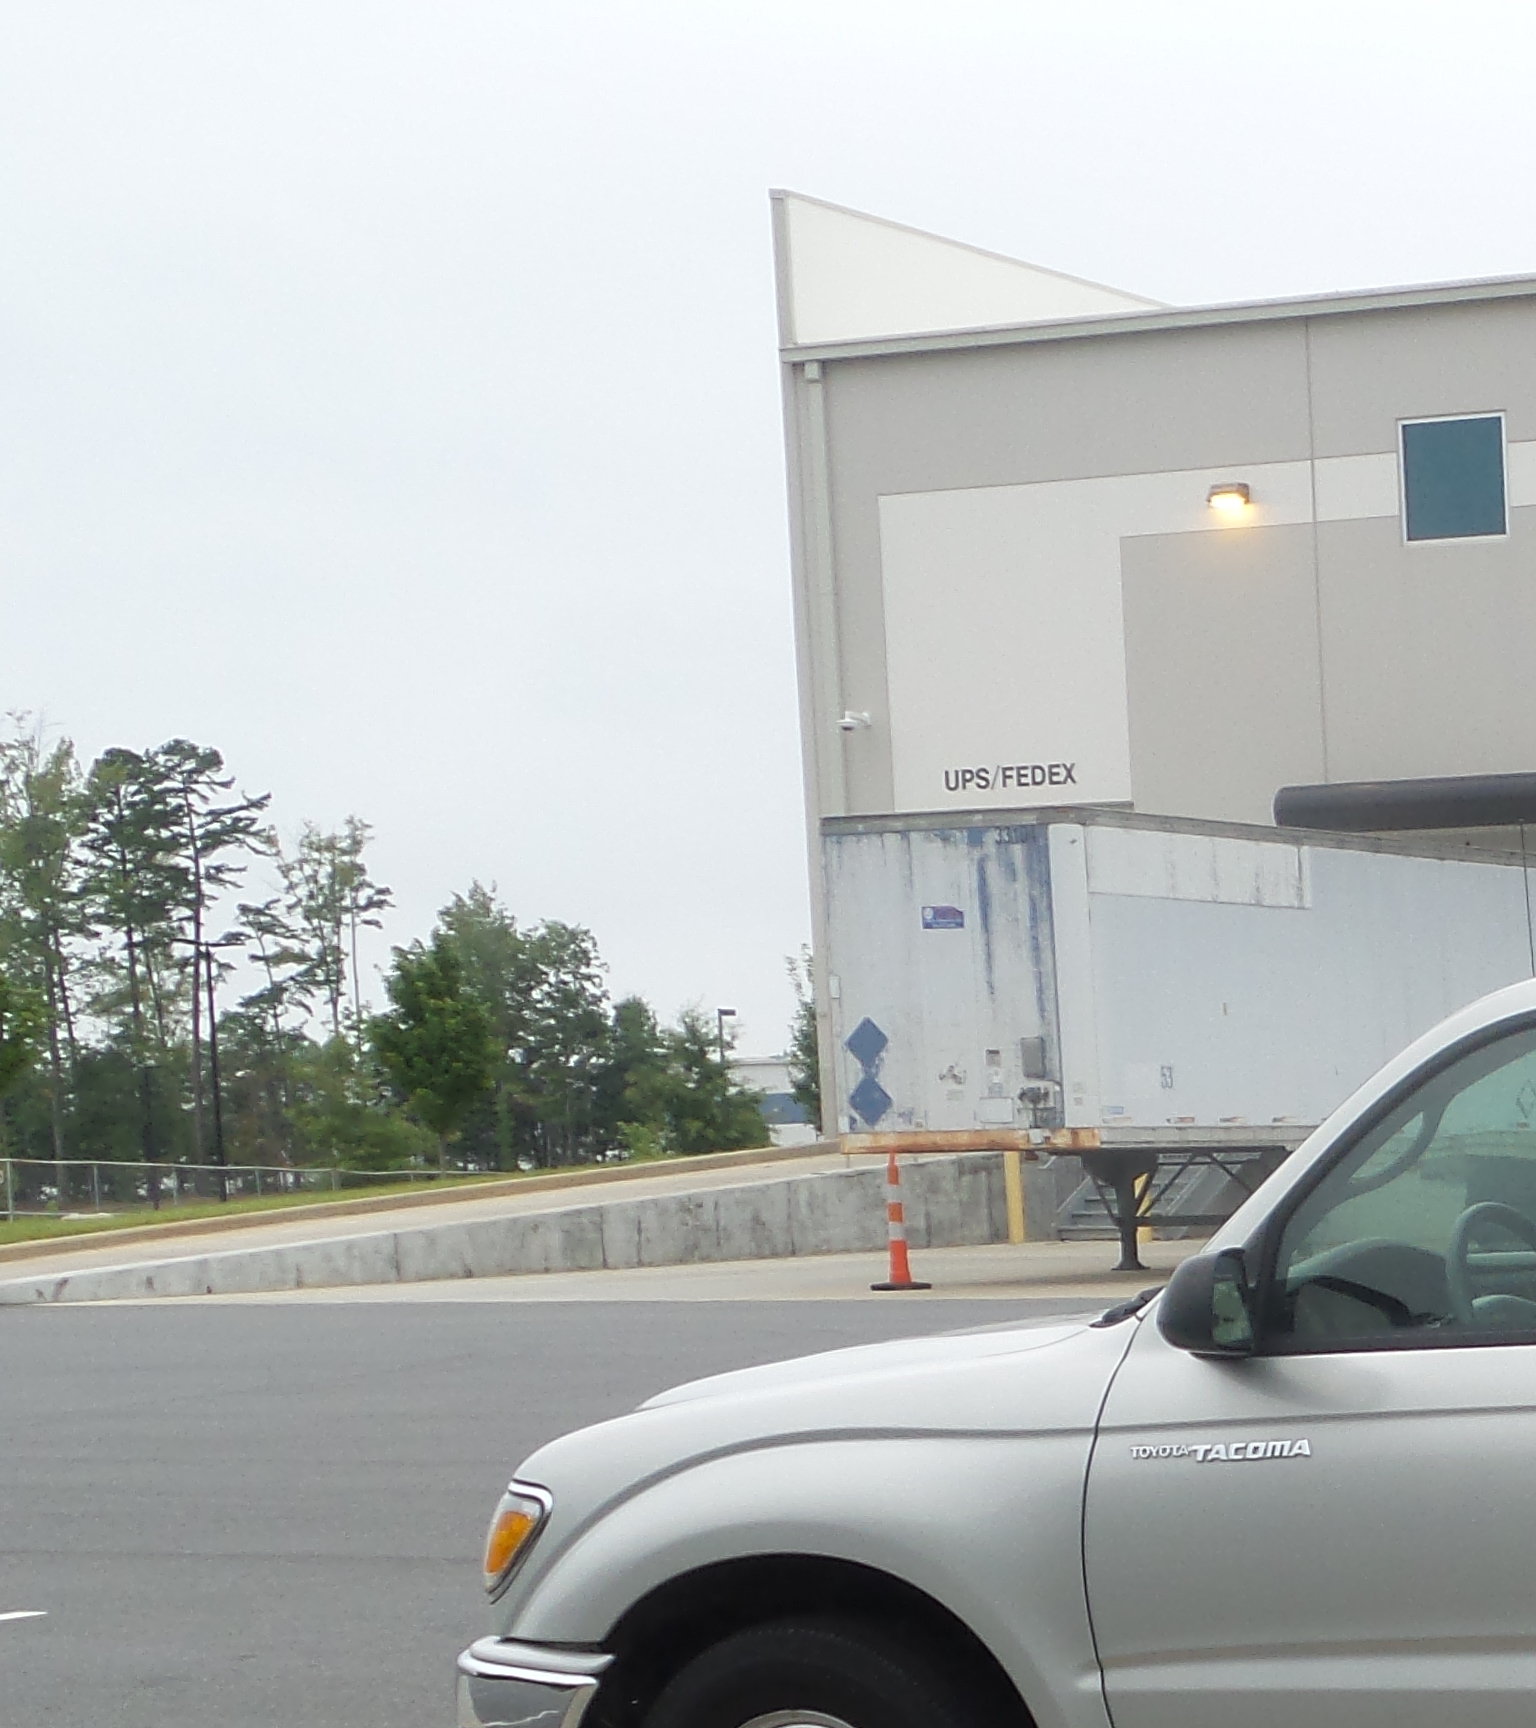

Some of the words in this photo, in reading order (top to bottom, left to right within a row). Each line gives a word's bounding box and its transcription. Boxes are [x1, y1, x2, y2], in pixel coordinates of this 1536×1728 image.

[944, 763, 1077, 791] UPS/FEDEX
[1130, 1444, 1190, 1460] TOYOTA
[1189, 1438, 1312, 1463] TACOMA
